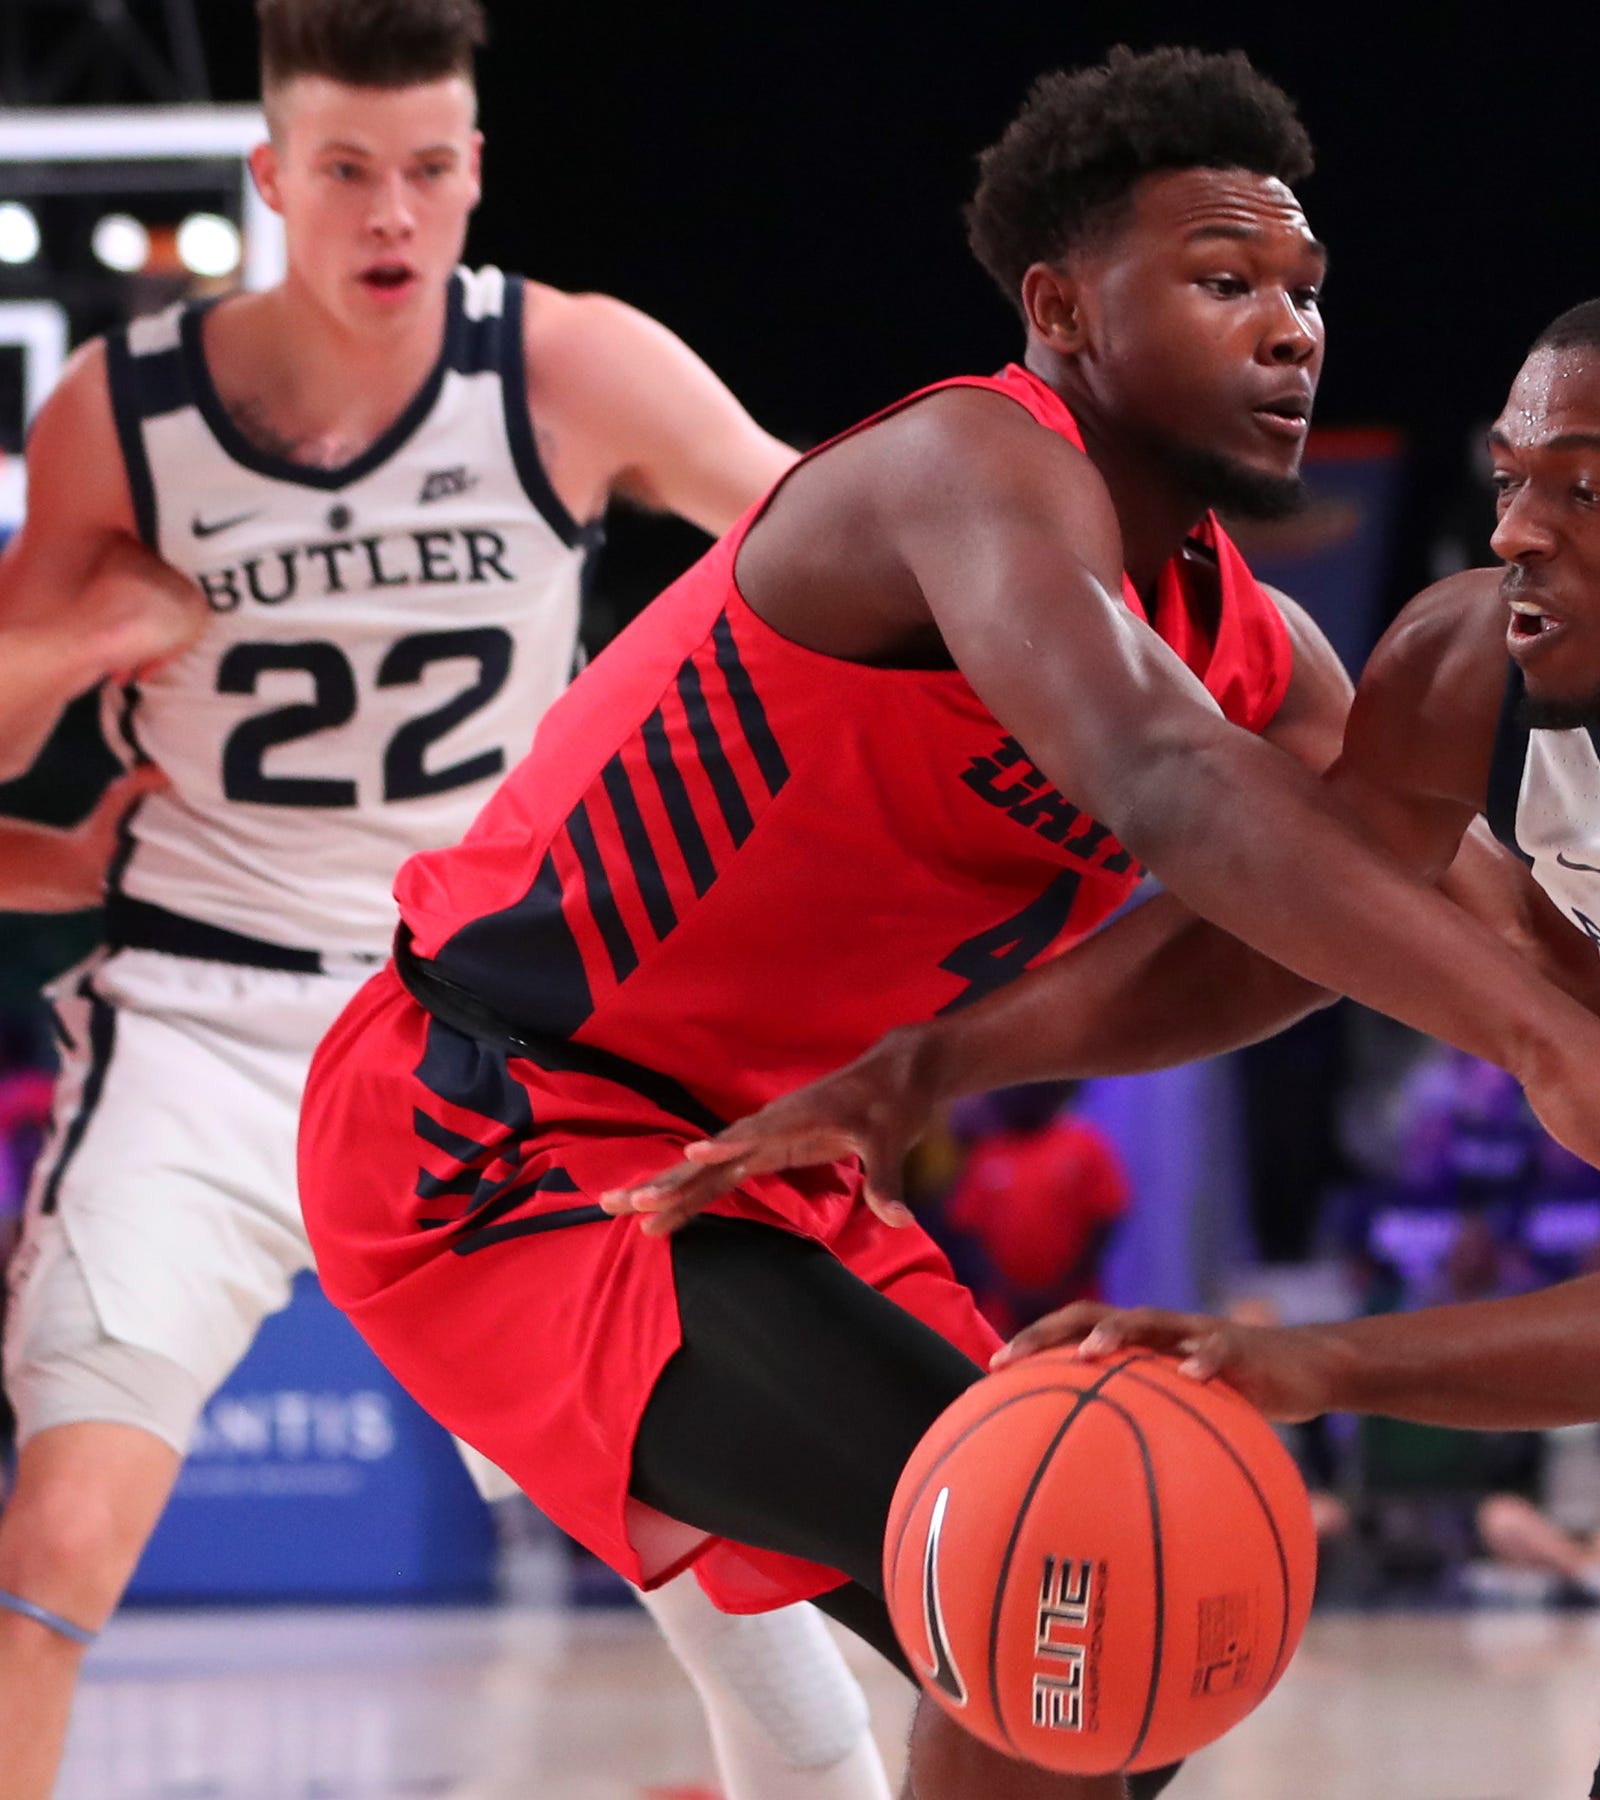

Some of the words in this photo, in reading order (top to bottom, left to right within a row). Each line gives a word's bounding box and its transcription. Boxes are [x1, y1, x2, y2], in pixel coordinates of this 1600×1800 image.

[199, 529, 516, 614] BUTLER
[215, 625, 515, 808] 22
[934, 868, 1083, 1017] 4
[1032, 1555, 1093, 1733] ELITE
